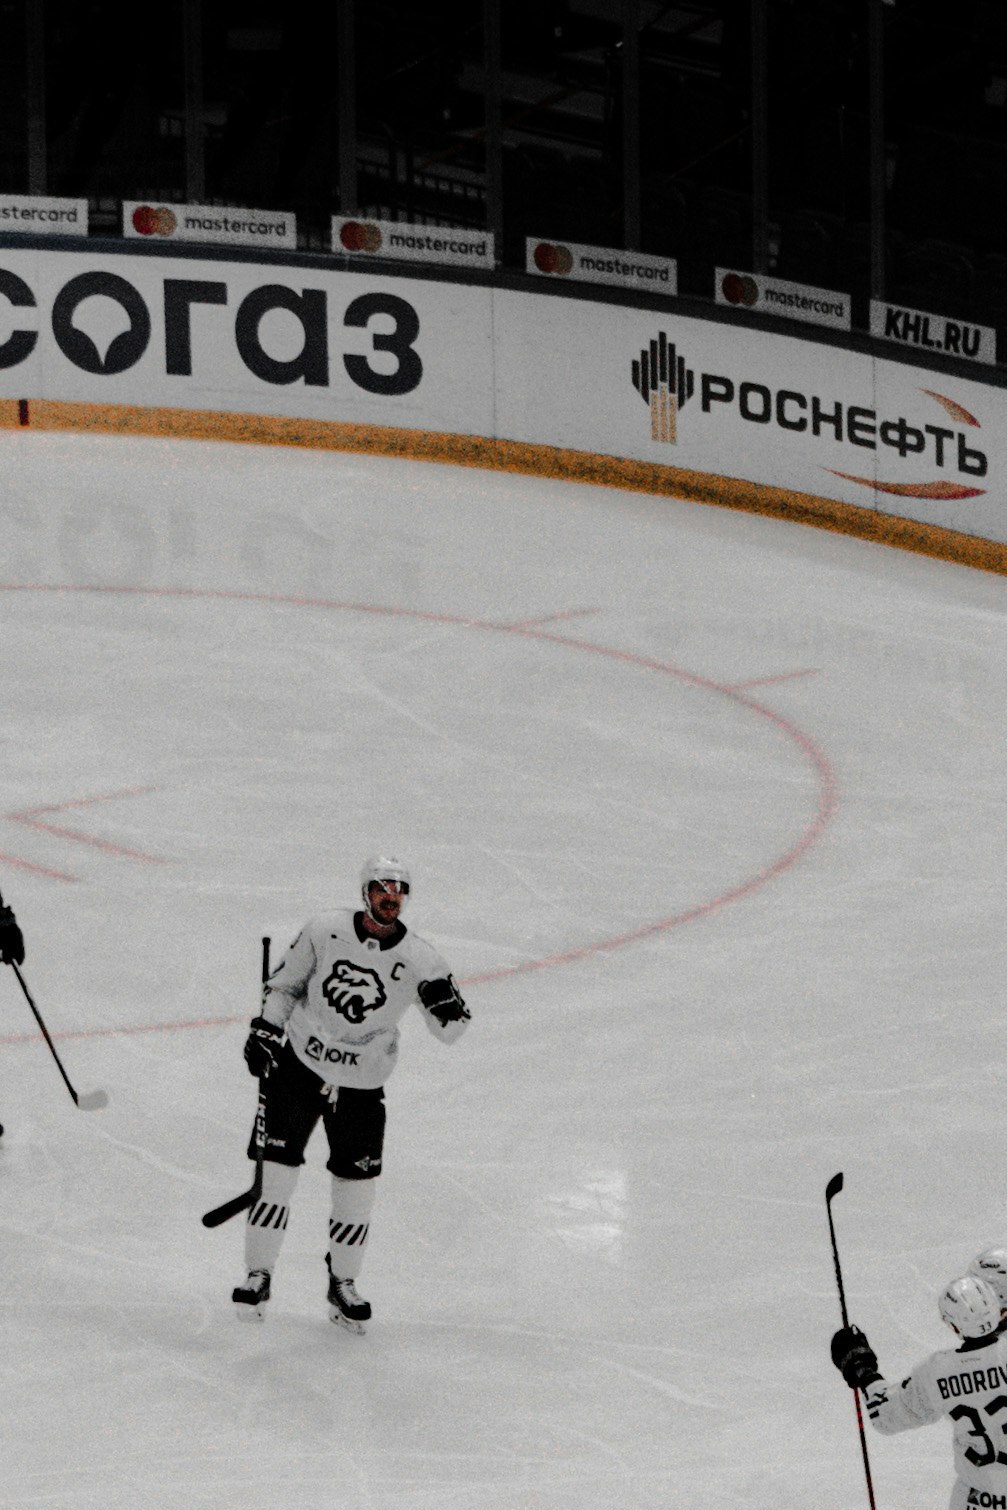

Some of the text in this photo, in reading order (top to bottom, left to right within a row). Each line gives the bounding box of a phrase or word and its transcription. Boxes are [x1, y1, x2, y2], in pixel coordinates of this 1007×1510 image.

[184, 214, 287, 237] mastercard
[389, 232, 487, 257] mastercard
[579, 254, 669, 282] mastercard
[764, 287, 844, 317] mastercard
[884, 307, 981, 356] KHL.RU
[701, 373, 988, 477] РОСНЕФТЬ
[390, 962, 405, 981] C
[324, 1047, 361, 1066] ЮГК
